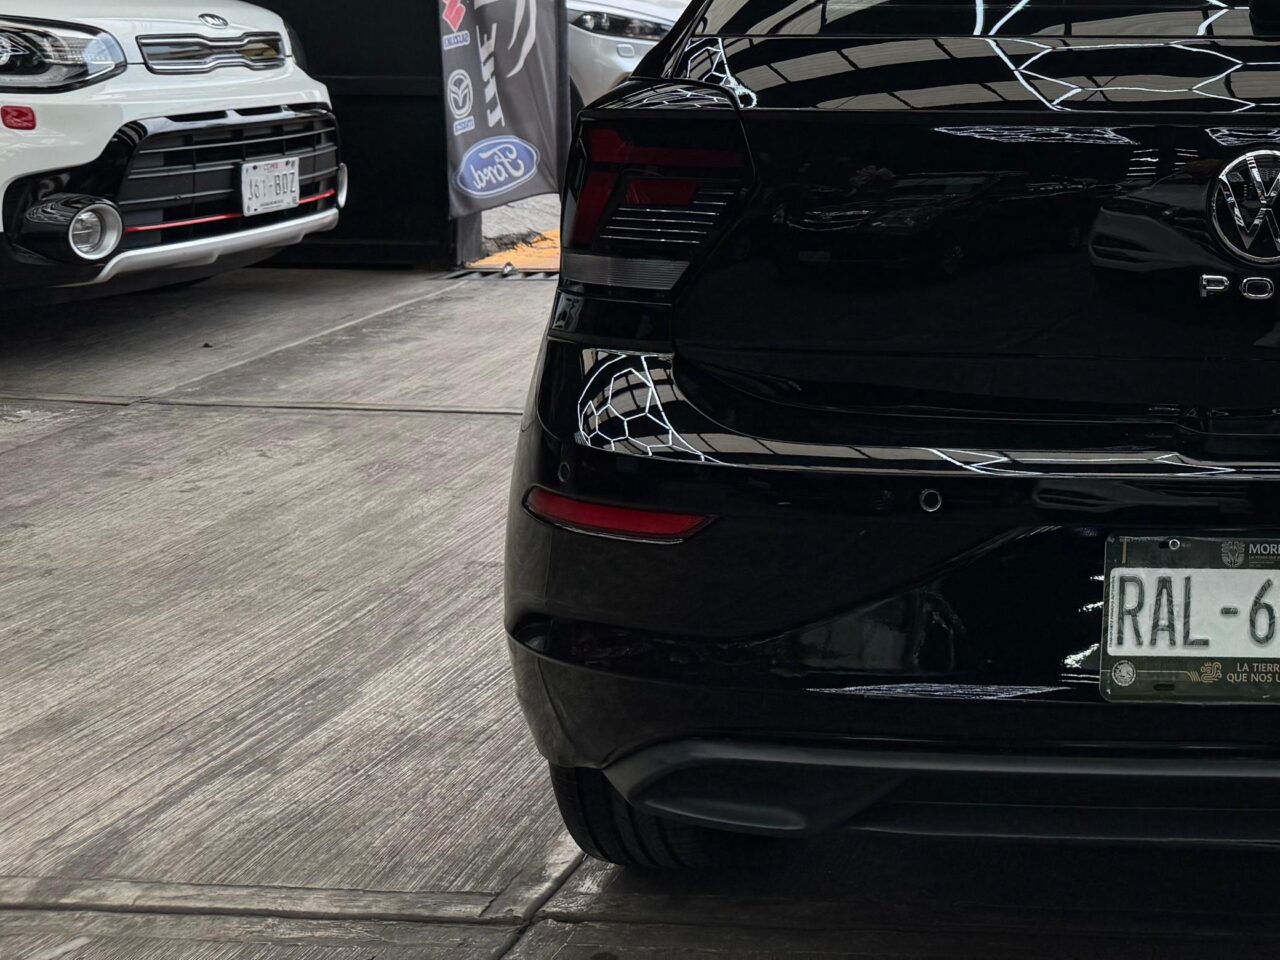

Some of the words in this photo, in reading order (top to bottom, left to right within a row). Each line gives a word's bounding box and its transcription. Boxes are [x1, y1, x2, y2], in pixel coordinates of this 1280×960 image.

[1237, 663, 1249, 672] LA
[1226, 673, 1248, 683] QUE
[1250, 673, 1273, 682] NOS
